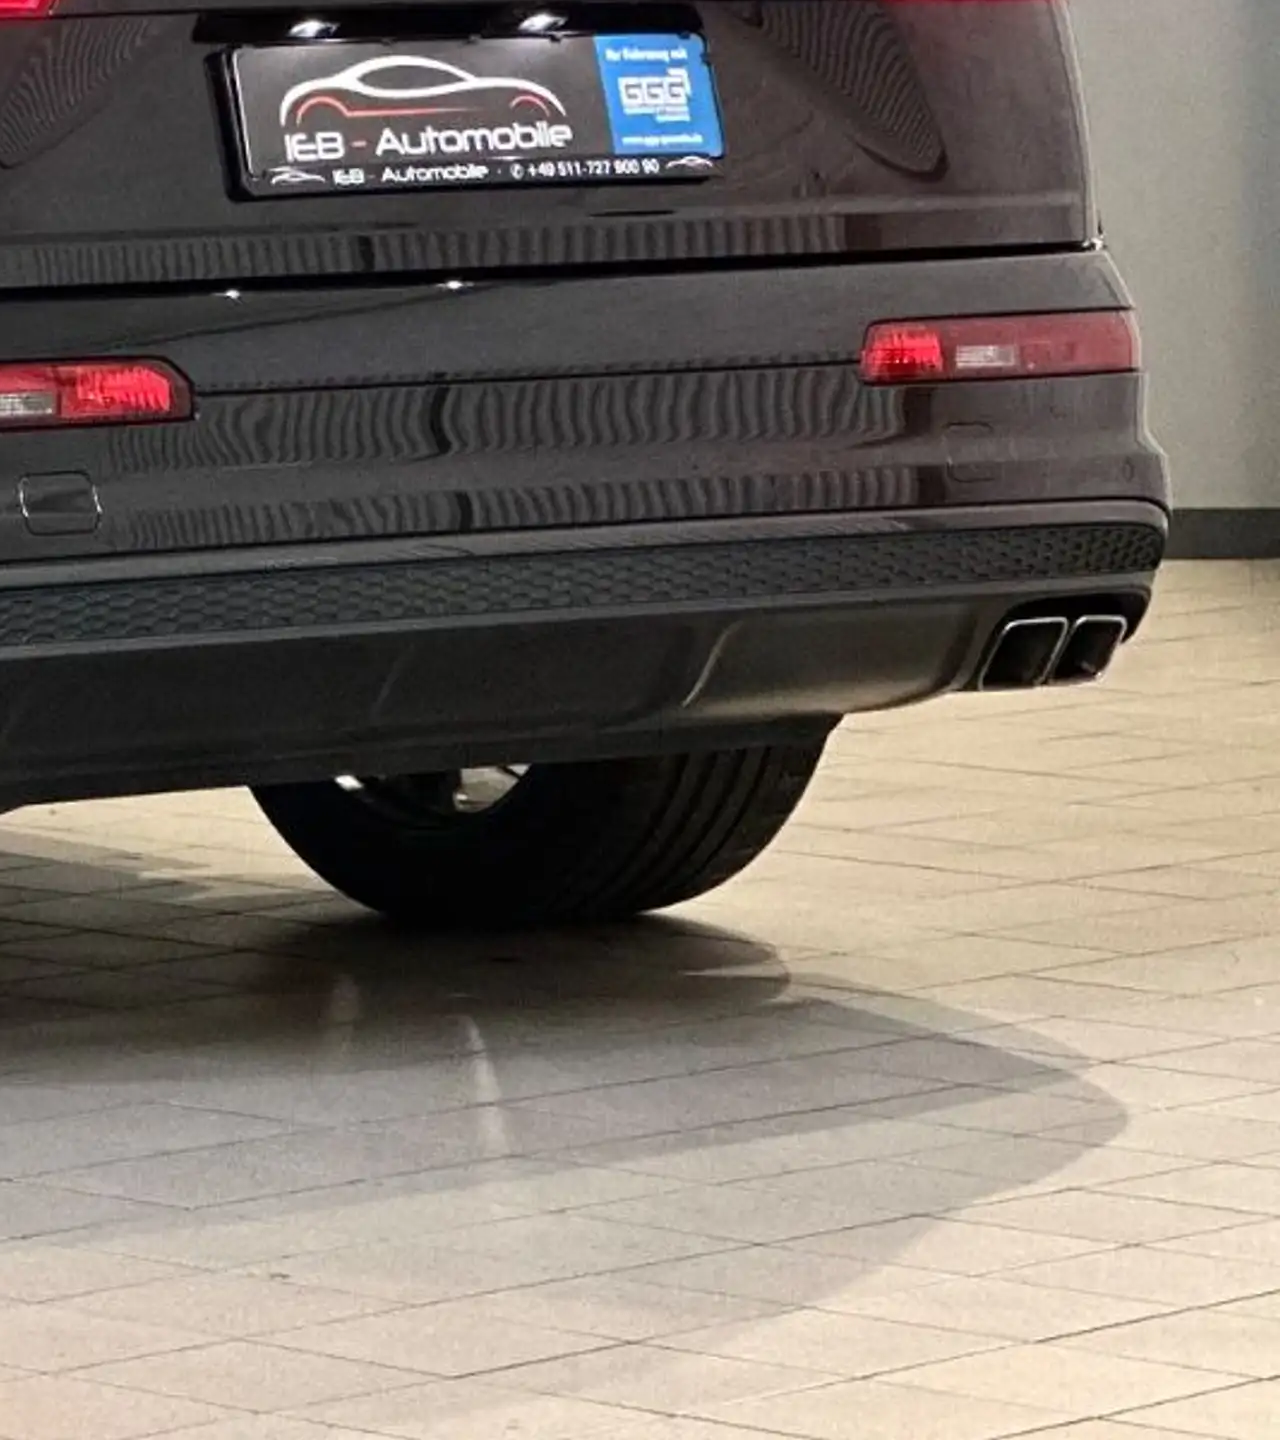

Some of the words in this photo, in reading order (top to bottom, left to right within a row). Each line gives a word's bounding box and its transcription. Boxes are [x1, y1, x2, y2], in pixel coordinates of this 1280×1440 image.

[283, 131, 346, 162] IEB
[375, 120, 573, 157] Automobile
[380, 163, 490, 183] Automobile
